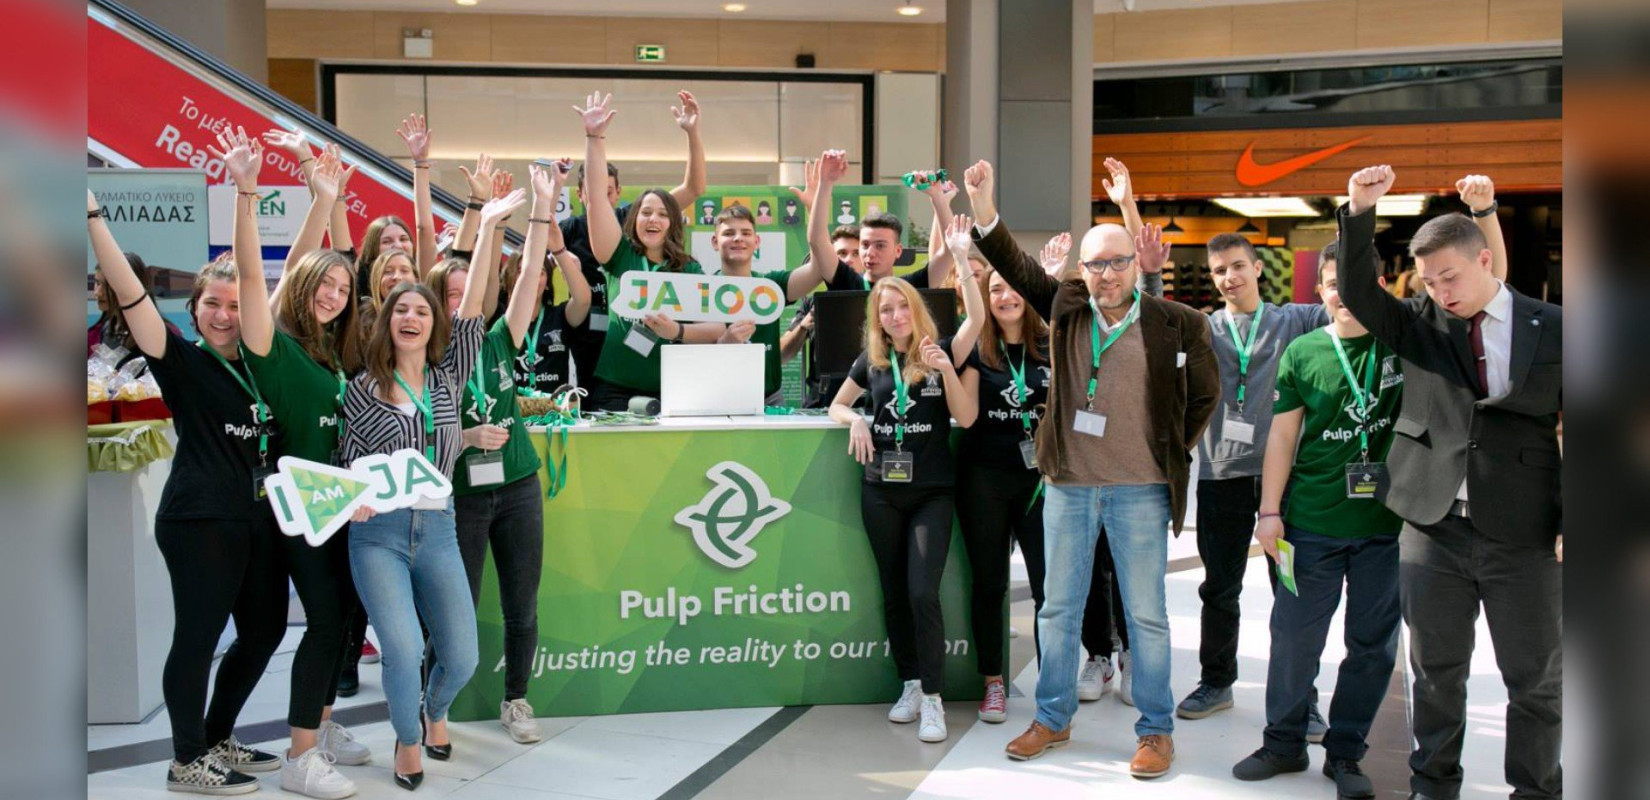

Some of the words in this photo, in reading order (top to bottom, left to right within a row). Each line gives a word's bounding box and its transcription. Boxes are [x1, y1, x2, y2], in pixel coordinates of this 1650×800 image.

[180, 96, 199, 120] Το
[155, 124, 236, 186] Read
[101, 205, 195, 222] ΑΛΙΑΔΑΣ
[628, 279, 683, 312] JA
[697, 282, 778, 316] 100
[225, 423, 252, 440] Pulp
[874, 423, 893, 437] Pulp
[1322, 427, 1352, 443] Pulp
[274, 485, 294, 523] I
[311, 484, 345, 505] AM
[368, 456, 444, 500] JA
[620, 586, 702, 626] Pulp
[714, 583, 851, 616] Friction
[645, 640, 691, 667] the
[699, 637, 787, 668] reality
[793, 639, 821, 660] to
[829, 641, 878, 659] our
